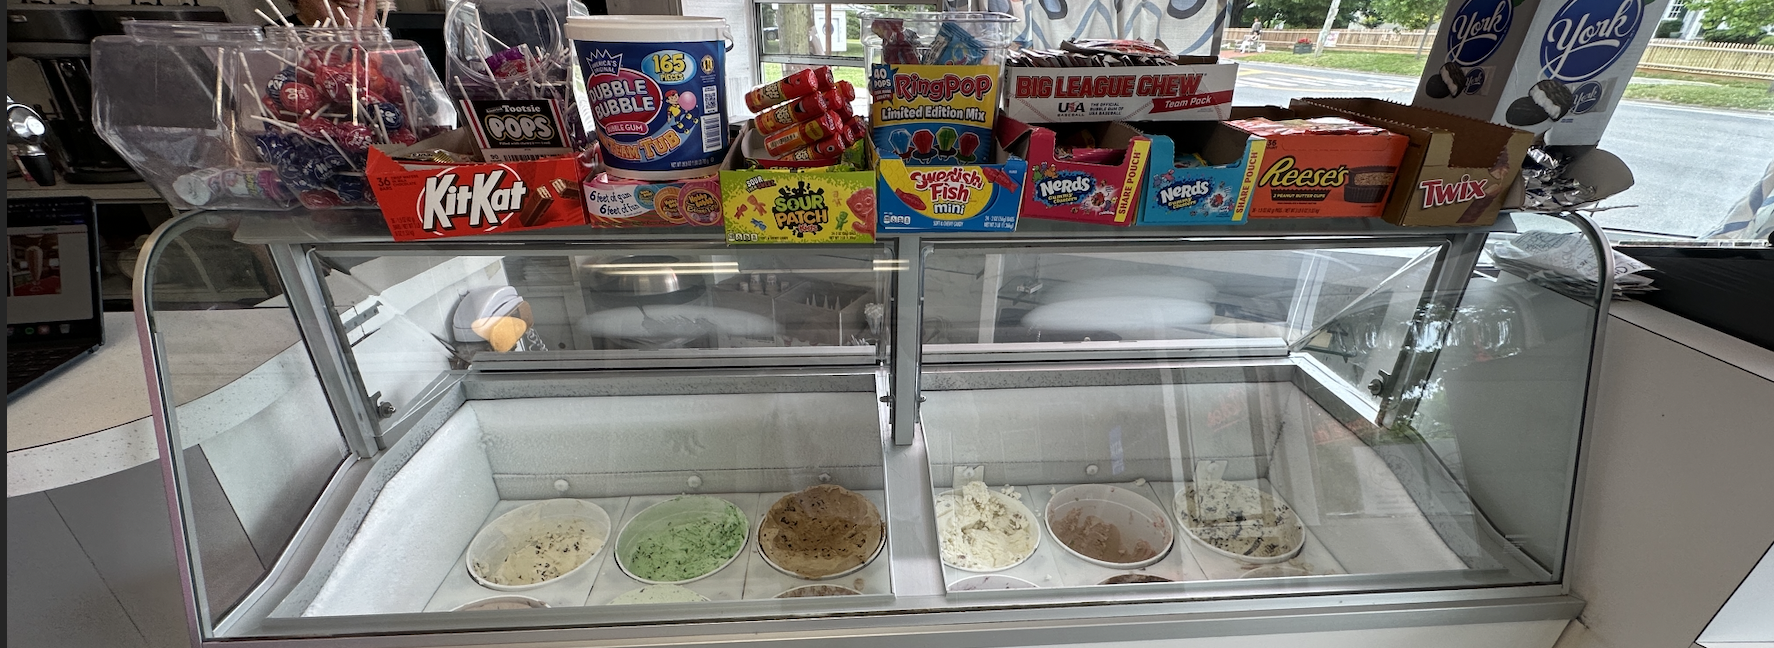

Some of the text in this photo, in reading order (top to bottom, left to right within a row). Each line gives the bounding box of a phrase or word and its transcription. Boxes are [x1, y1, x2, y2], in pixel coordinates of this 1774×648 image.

[1448, 1, 1507, 61] York
[1543, 0, 1634, 78] York
[652, 53, 686, 73] 165
[660, 73, 684, 82] PIECES
[873, 68, 887, 80] 40
[588, 79, 648, 102] DUBBLE
[1015, 73, 1204, 98] BIG LEAGUE CHEW
[502, 104, 541, 113] Tootsie
[595, 96, 655, 120] BUBBLE
[1058, 101, 1085, 113] USA
[1165, 96, 1212, 108] Team Pack
[882, 105, 986, 122] Limited Edition Mix
[486, 115, 554, 139] POPS
[625, 123, 643, 132] GUM
[640, 131, 681, 158] TUB
[910, 167, 985, 189] Swedish
[1258, 155, 1350, 188] Reese's
[378, 176, 391, 187] 36
[746, 175, 763, 187] SOUR
[1119, 153, 1141, 214] SHARE POUCH
[1236, 152, 1258, 213] SHARE POUCH
[590, 190, 596, 201] 6
[596, 192, 610, 203] feet
[610, 191, 617, 202] of
[617, 192, 632, 203] gum
[931, 183, 970, 203] Fish
[600, 204, 607, 214] 6
[607, 205, 621, 215] feet
[627, 203, 640, 212] fun
[774, 194, 824, 212] SOUR
[934, 202, 965, 214] mini
[775, 209, 828, 227] PATCH
